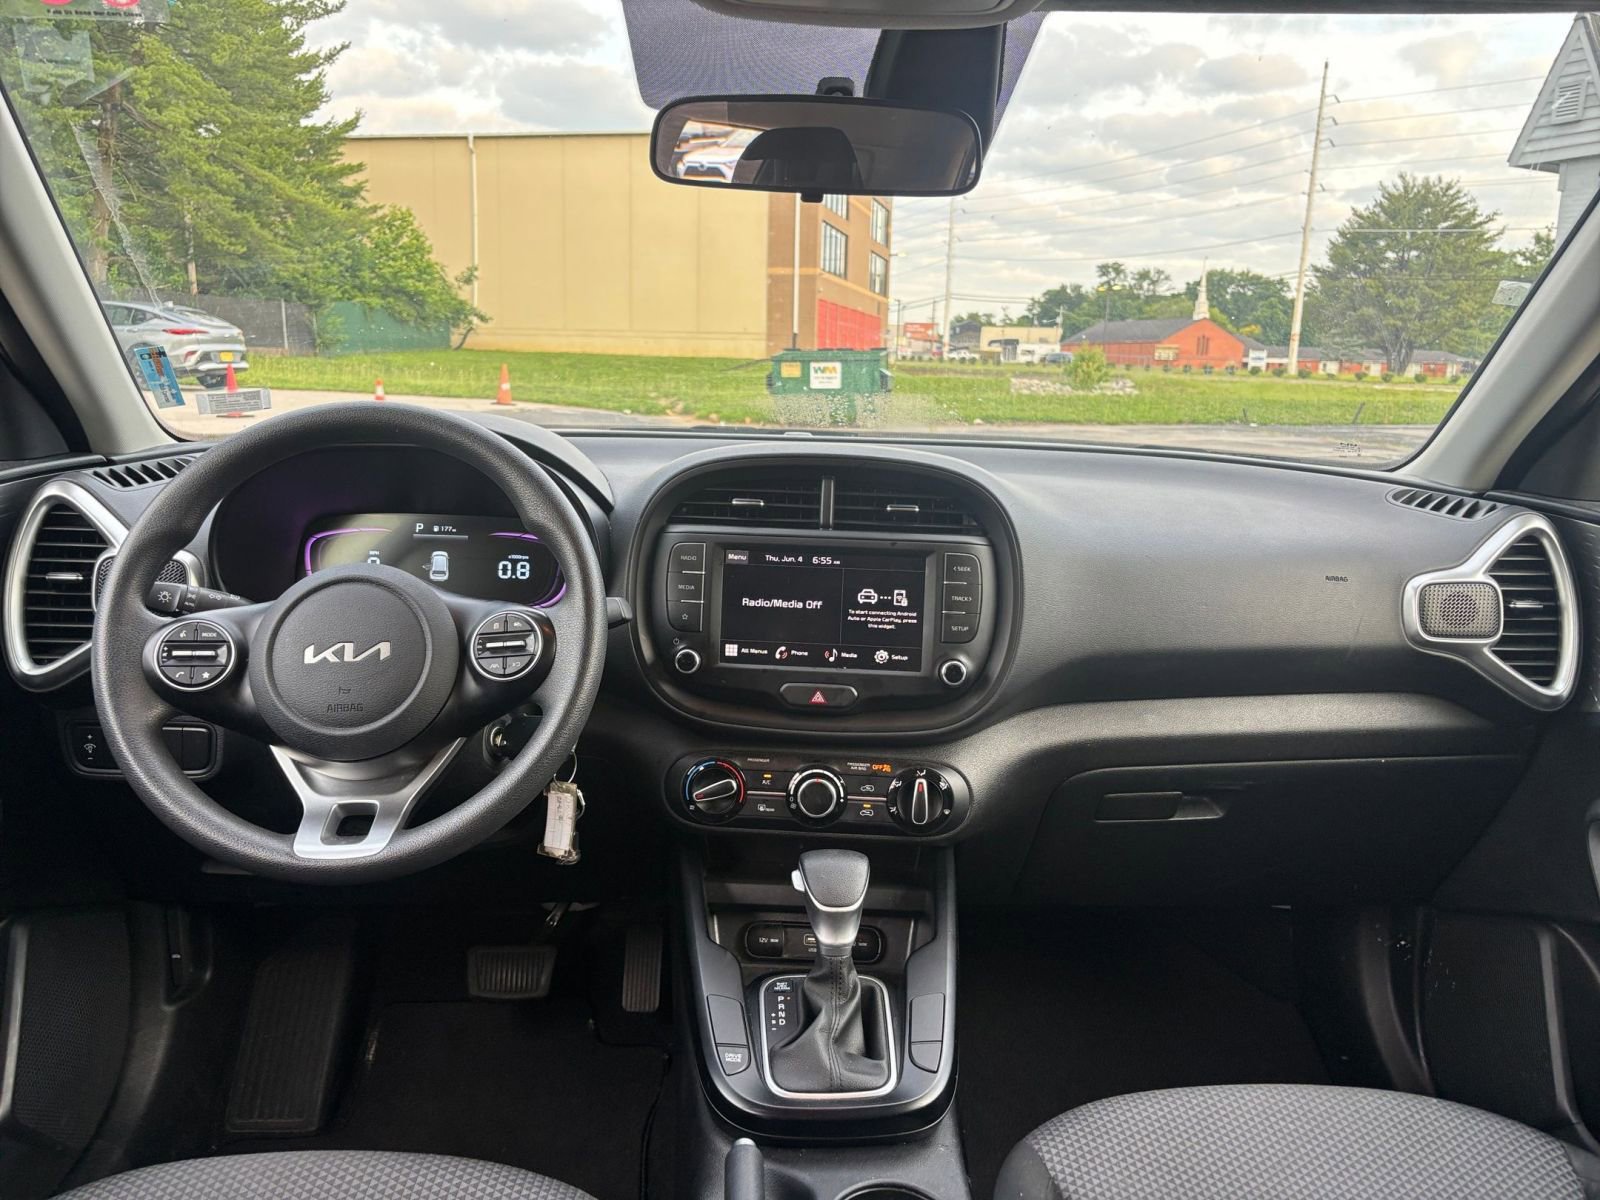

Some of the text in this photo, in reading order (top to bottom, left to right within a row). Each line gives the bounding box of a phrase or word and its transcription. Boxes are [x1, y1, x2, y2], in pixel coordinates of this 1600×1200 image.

[416, 522, 424, 532] P
[812, 556, 832, 564] 6:55
[498, 560, 530, 580] 0.8
[742, 598, 822, 609] Radio/Media Off
[304, 642, 390, 664] KIA
[327, 703, 364, 713] AIRBAG
